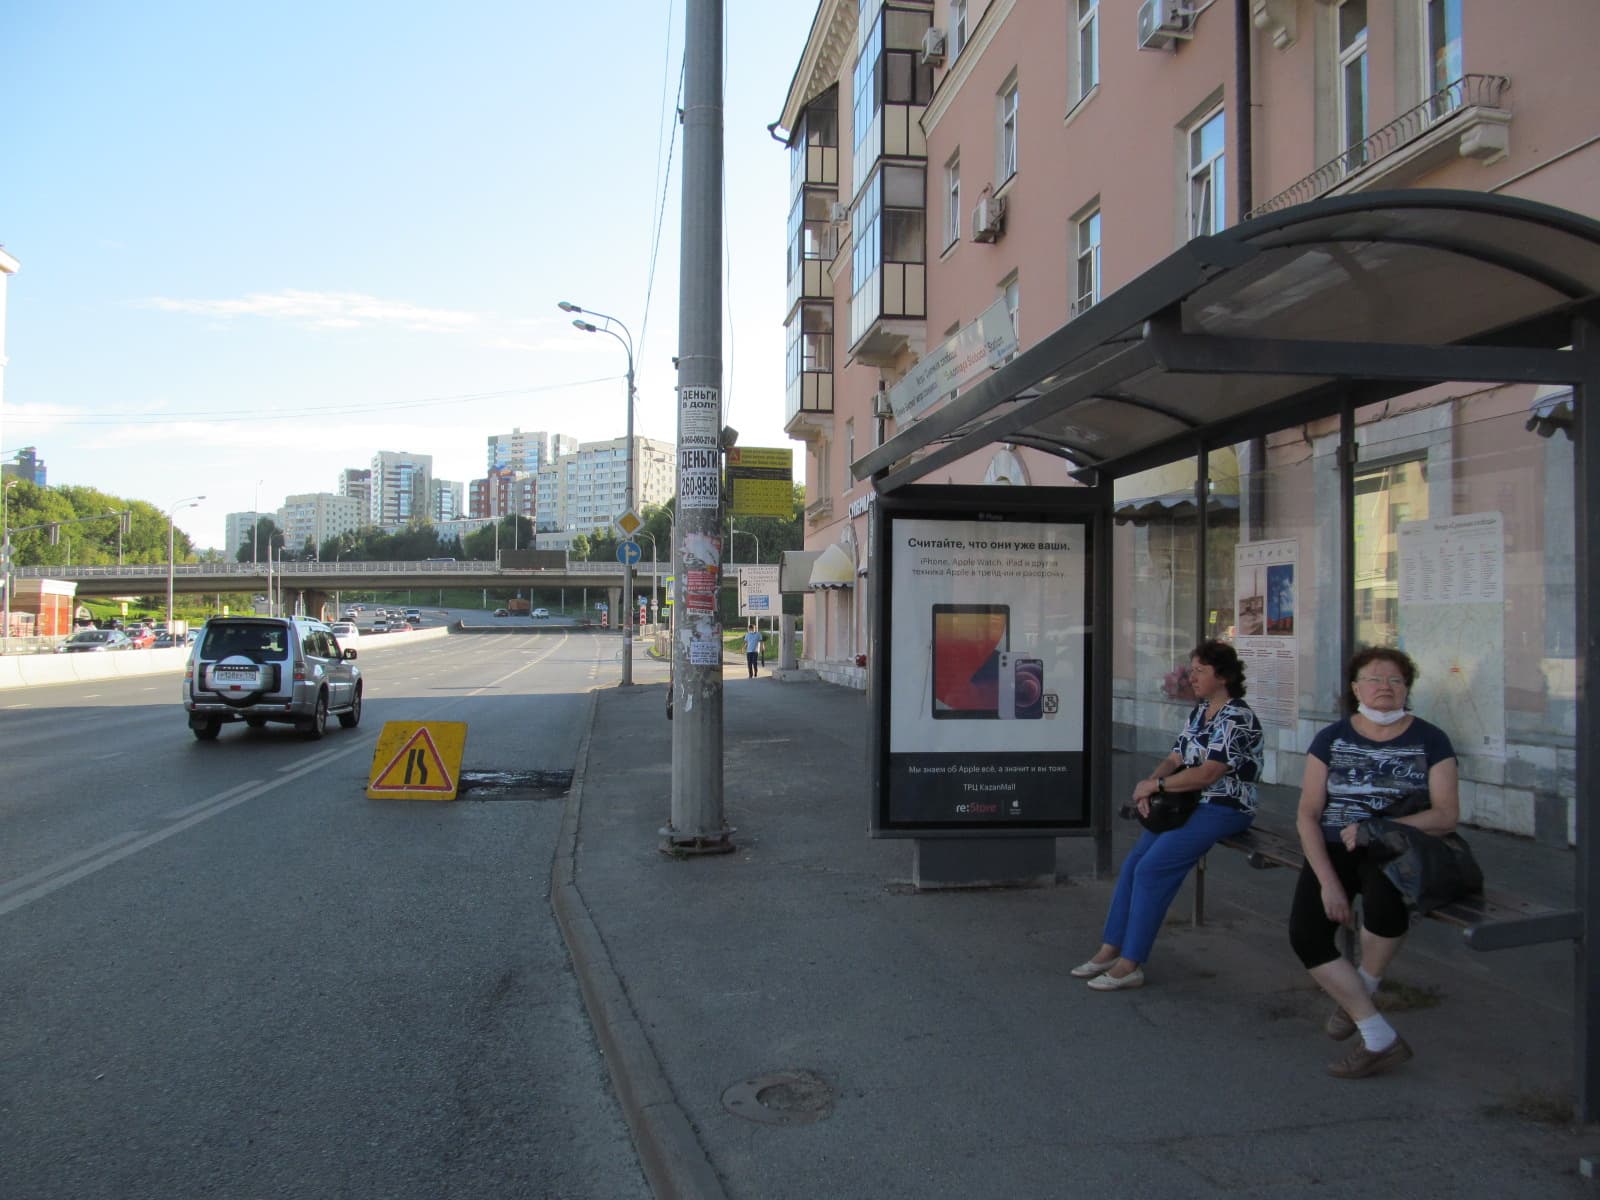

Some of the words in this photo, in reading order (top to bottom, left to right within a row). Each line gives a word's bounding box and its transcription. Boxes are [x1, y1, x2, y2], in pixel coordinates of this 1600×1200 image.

[683, 390, 717, 401] ДЕНЬГИ
[682, 451, 718, 472] ДЕНЬГИ
[908, 537, 966, 550] Считайте,
[968, 541, 988, 549] что
[990, 541, 1011, 550] они
[1014, 541, 1036, 552] уже
[1038, 542, 1071, 551] ваши.
[952, 558, 975, 568] Apple
[1006, 559, 1023, 567] iPad
[912, 569, 944, 577] техника
[946, 568, 969, 578] Apple
[947, 765, 957, 773] об
[959, 765, 980, 774] Apple
[1391, 764, 1425, 780] Sea
[963, 783, 978, 792] ТРЦ
[979, 783, 1016, 791] KazanMall
